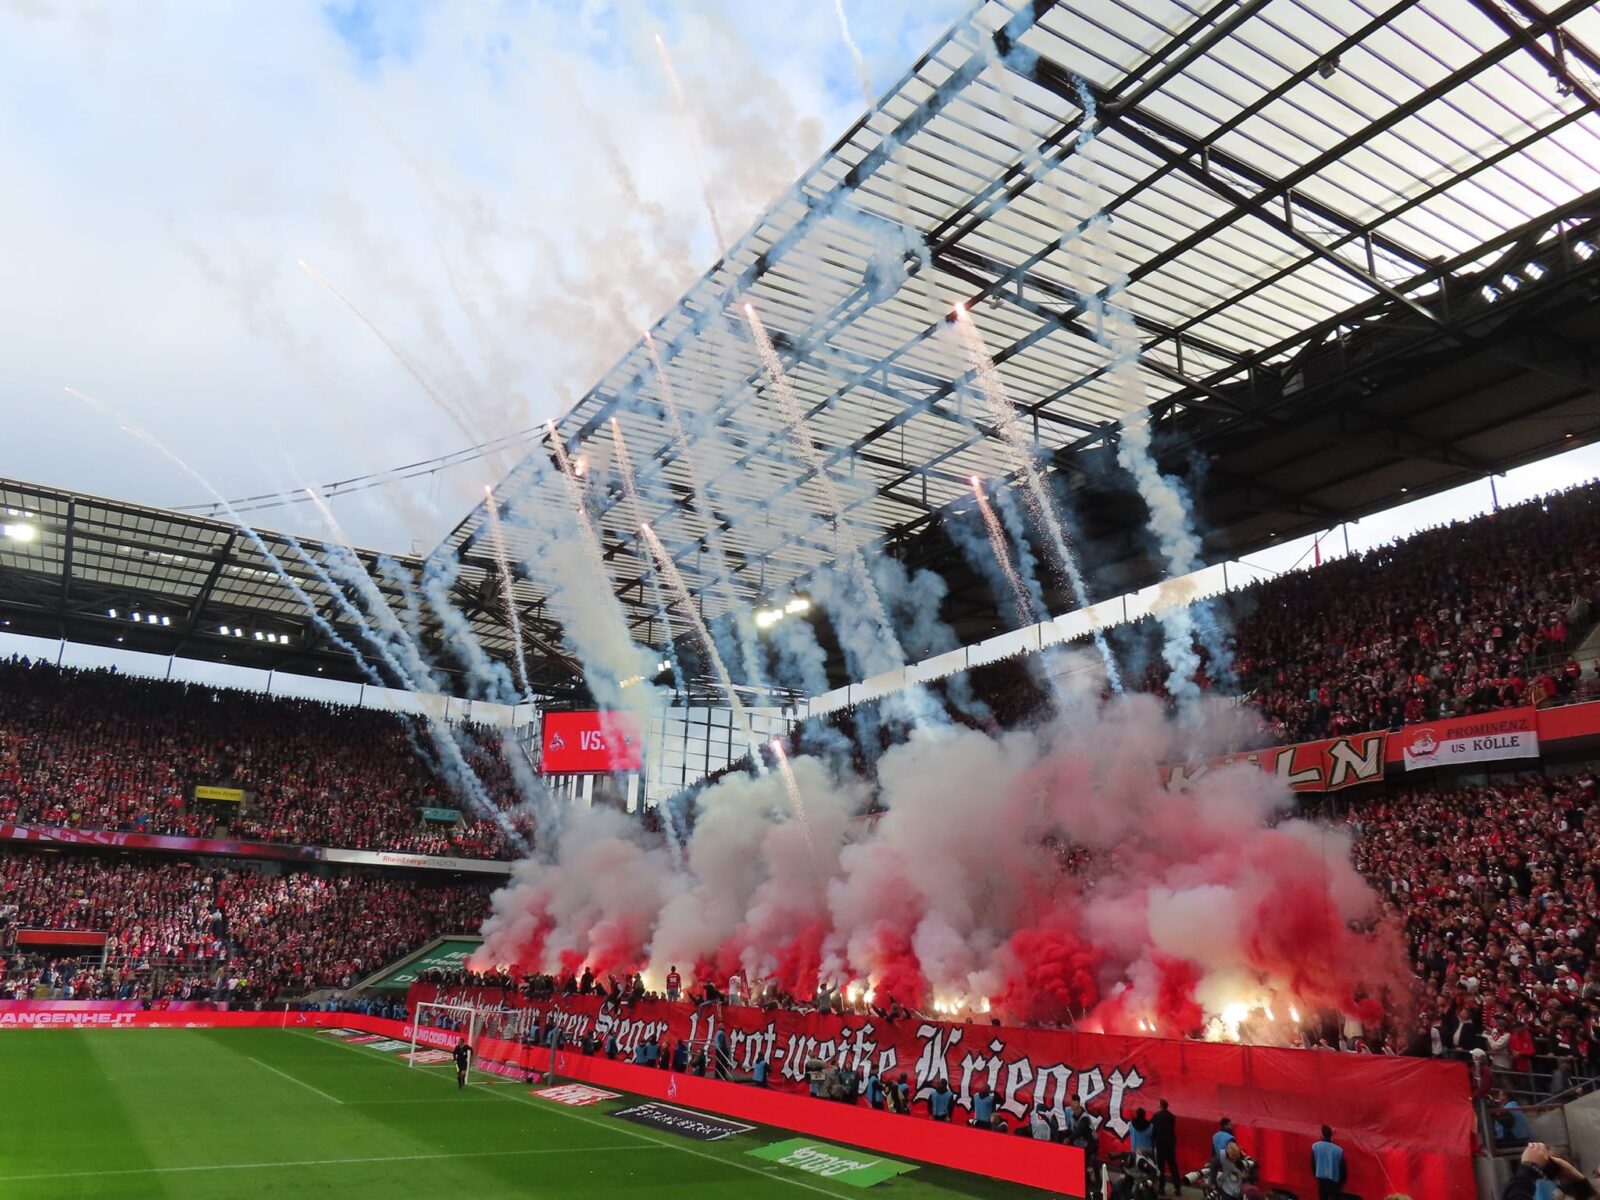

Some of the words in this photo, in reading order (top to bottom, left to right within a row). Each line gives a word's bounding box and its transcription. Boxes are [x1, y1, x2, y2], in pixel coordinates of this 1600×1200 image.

[1446, 719, 1529, 739] PROMINENZ
[580, 730, 606, 751] VS.
[1451, 743, 1466, 753] US
[1473, 736, 1520, 751] KÖLLE
[1165, 738, 1380, 794] KLN
[913, 1024, 1144, 1139] Krieger
